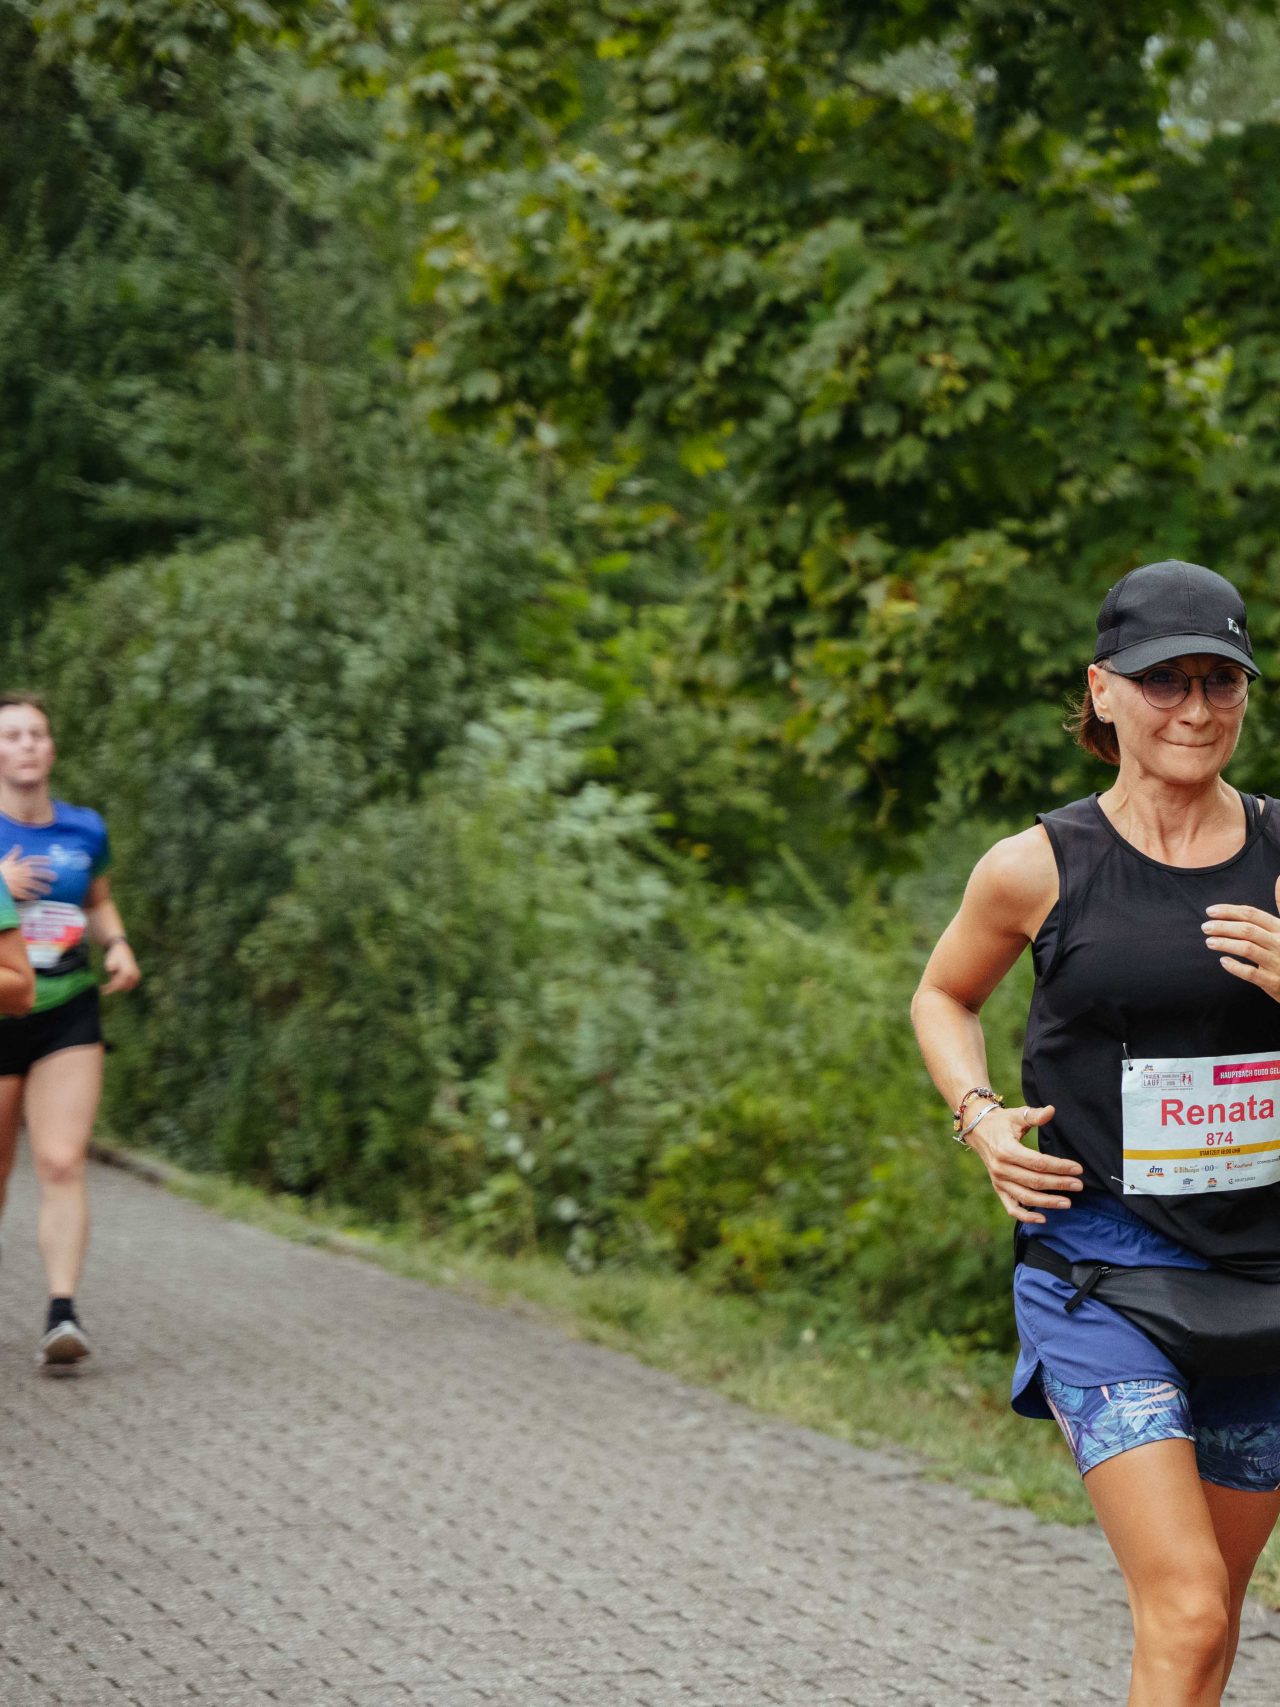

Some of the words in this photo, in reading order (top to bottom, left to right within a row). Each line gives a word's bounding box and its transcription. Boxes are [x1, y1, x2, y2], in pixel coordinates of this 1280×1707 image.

[1220, 1070, 1253, 1079] HAUPTSACH
[1161, 1094, 1275, 1126] Renata
[1206, 1131, 1233, 1146] 874
[1149, 1165, 1163, 1173] dm
